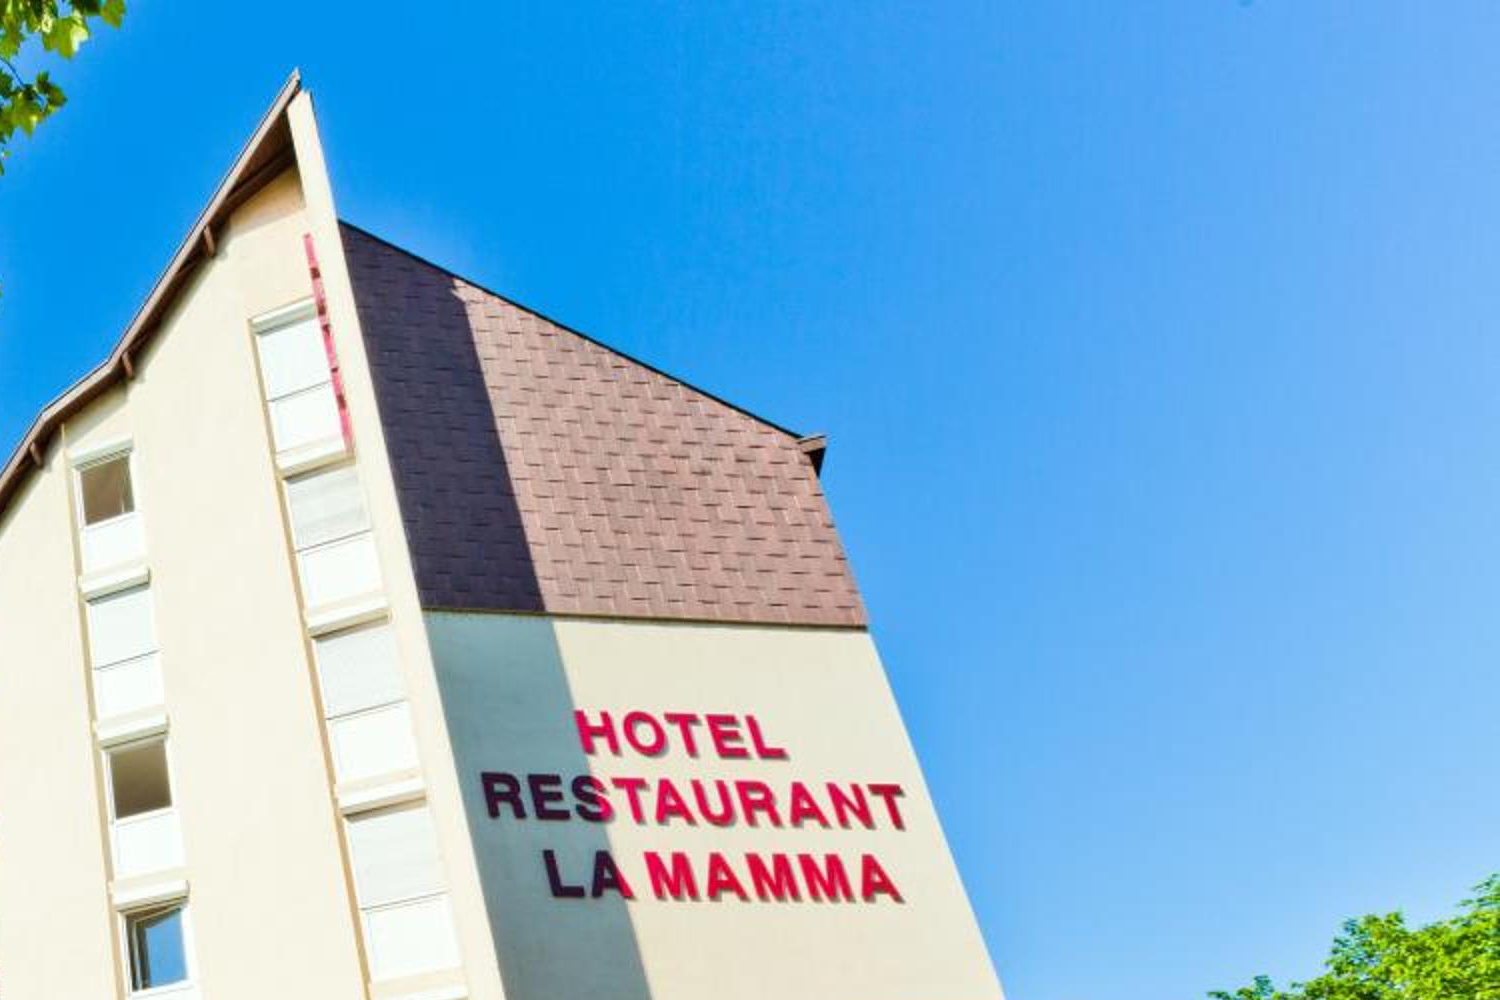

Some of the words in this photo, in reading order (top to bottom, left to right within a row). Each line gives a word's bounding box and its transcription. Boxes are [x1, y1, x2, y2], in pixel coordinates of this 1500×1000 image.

[574, 709, 789, 761] HOTEL
[480, 771, 906, 830] RESTAURANT
[542, 849, 633, 900] LA
[643, 851, 904, 903] MAMMA
